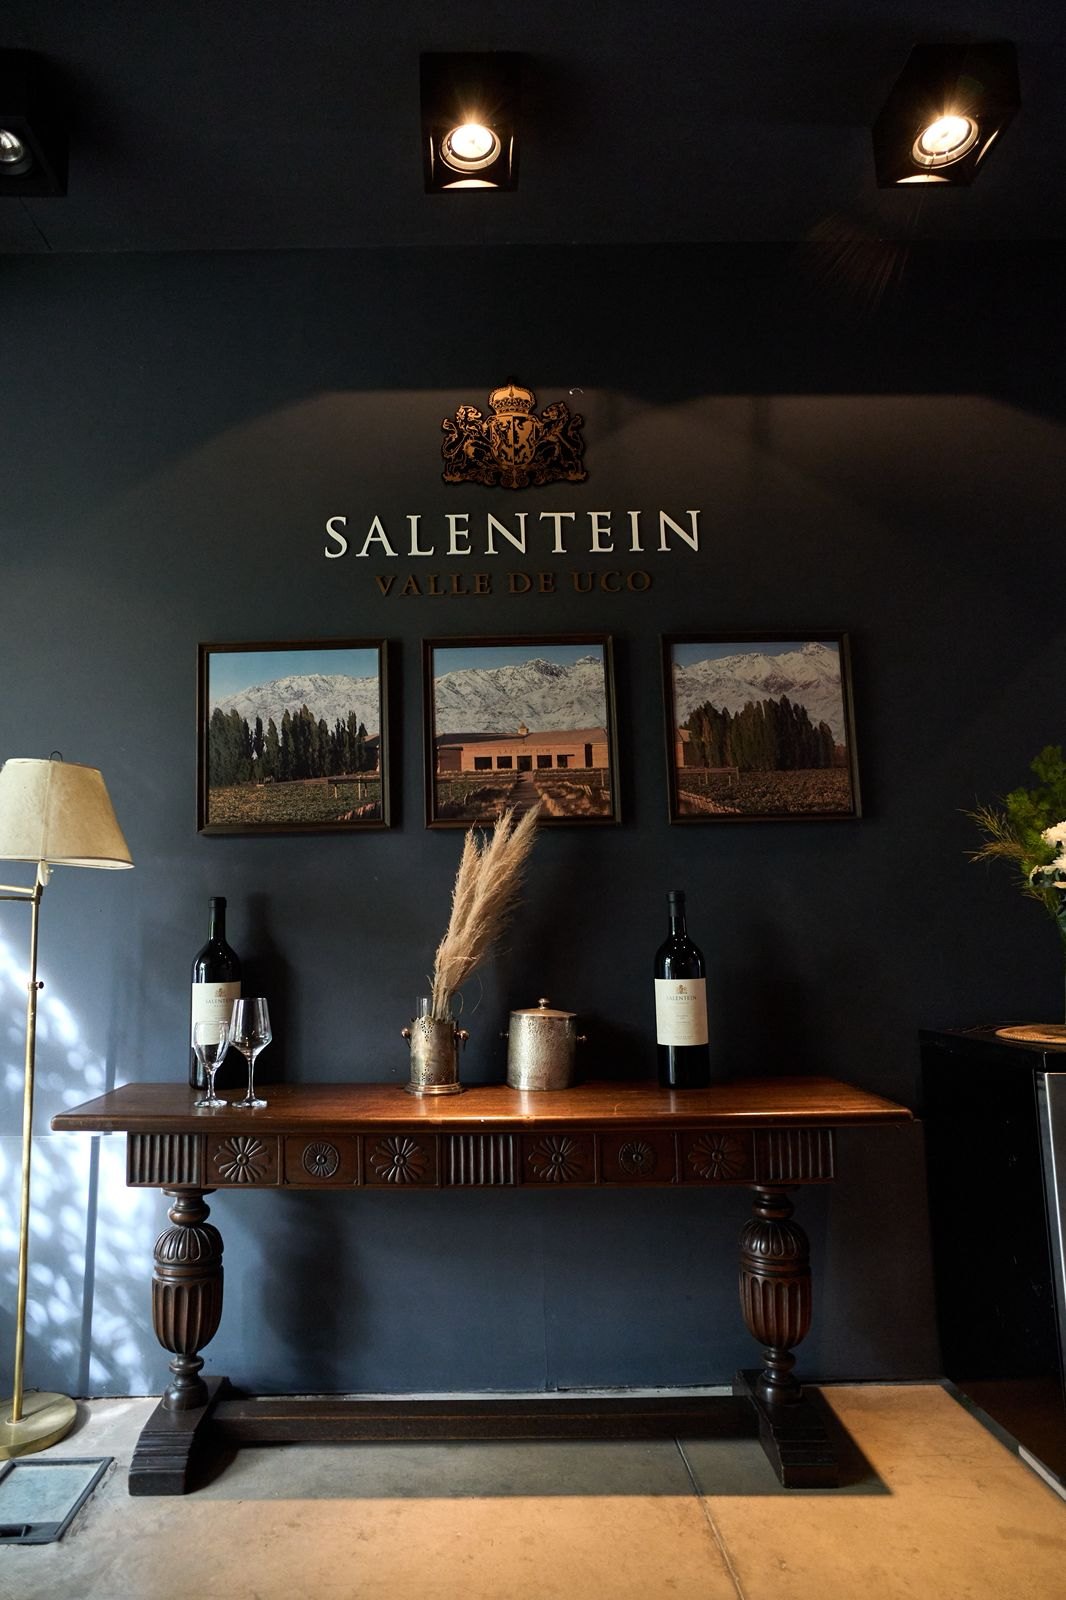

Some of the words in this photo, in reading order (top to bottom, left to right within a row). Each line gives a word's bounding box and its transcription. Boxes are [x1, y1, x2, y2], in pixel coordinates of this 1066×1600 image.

[324, 510, 701, 558] SALENTEIN
[375, 571, 493, 597] VALLE
[506, 571, 556, 594] DE
[571, 570, 654, 593] UCO
